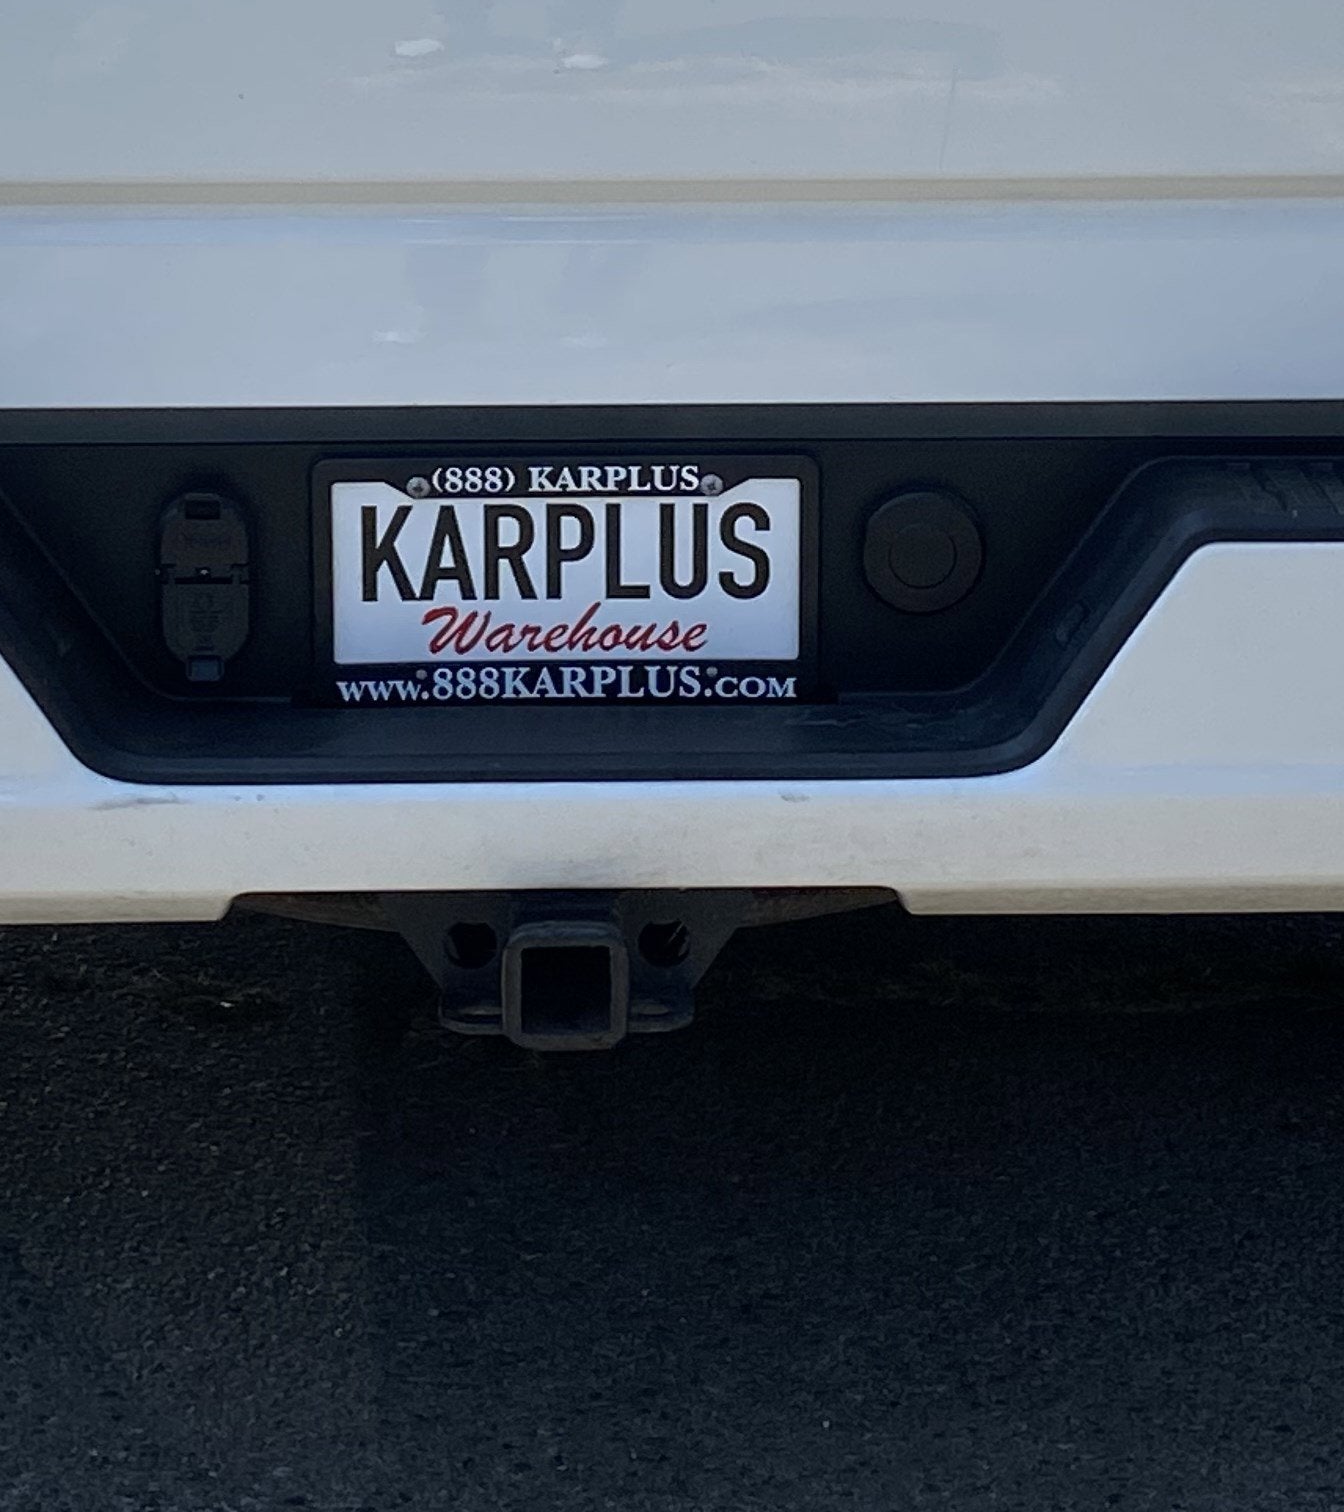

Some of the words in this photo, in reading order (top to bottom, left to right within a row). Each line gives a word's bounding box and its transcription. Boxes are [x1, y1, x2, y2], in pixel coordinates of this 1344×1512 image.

[431, 466, 516, 494] (888)
[528, 464, 701, 493] KARPLUS
[360, 501, 773, 603] KARPLUS
[421, 600, 709, 655] Warehouse
